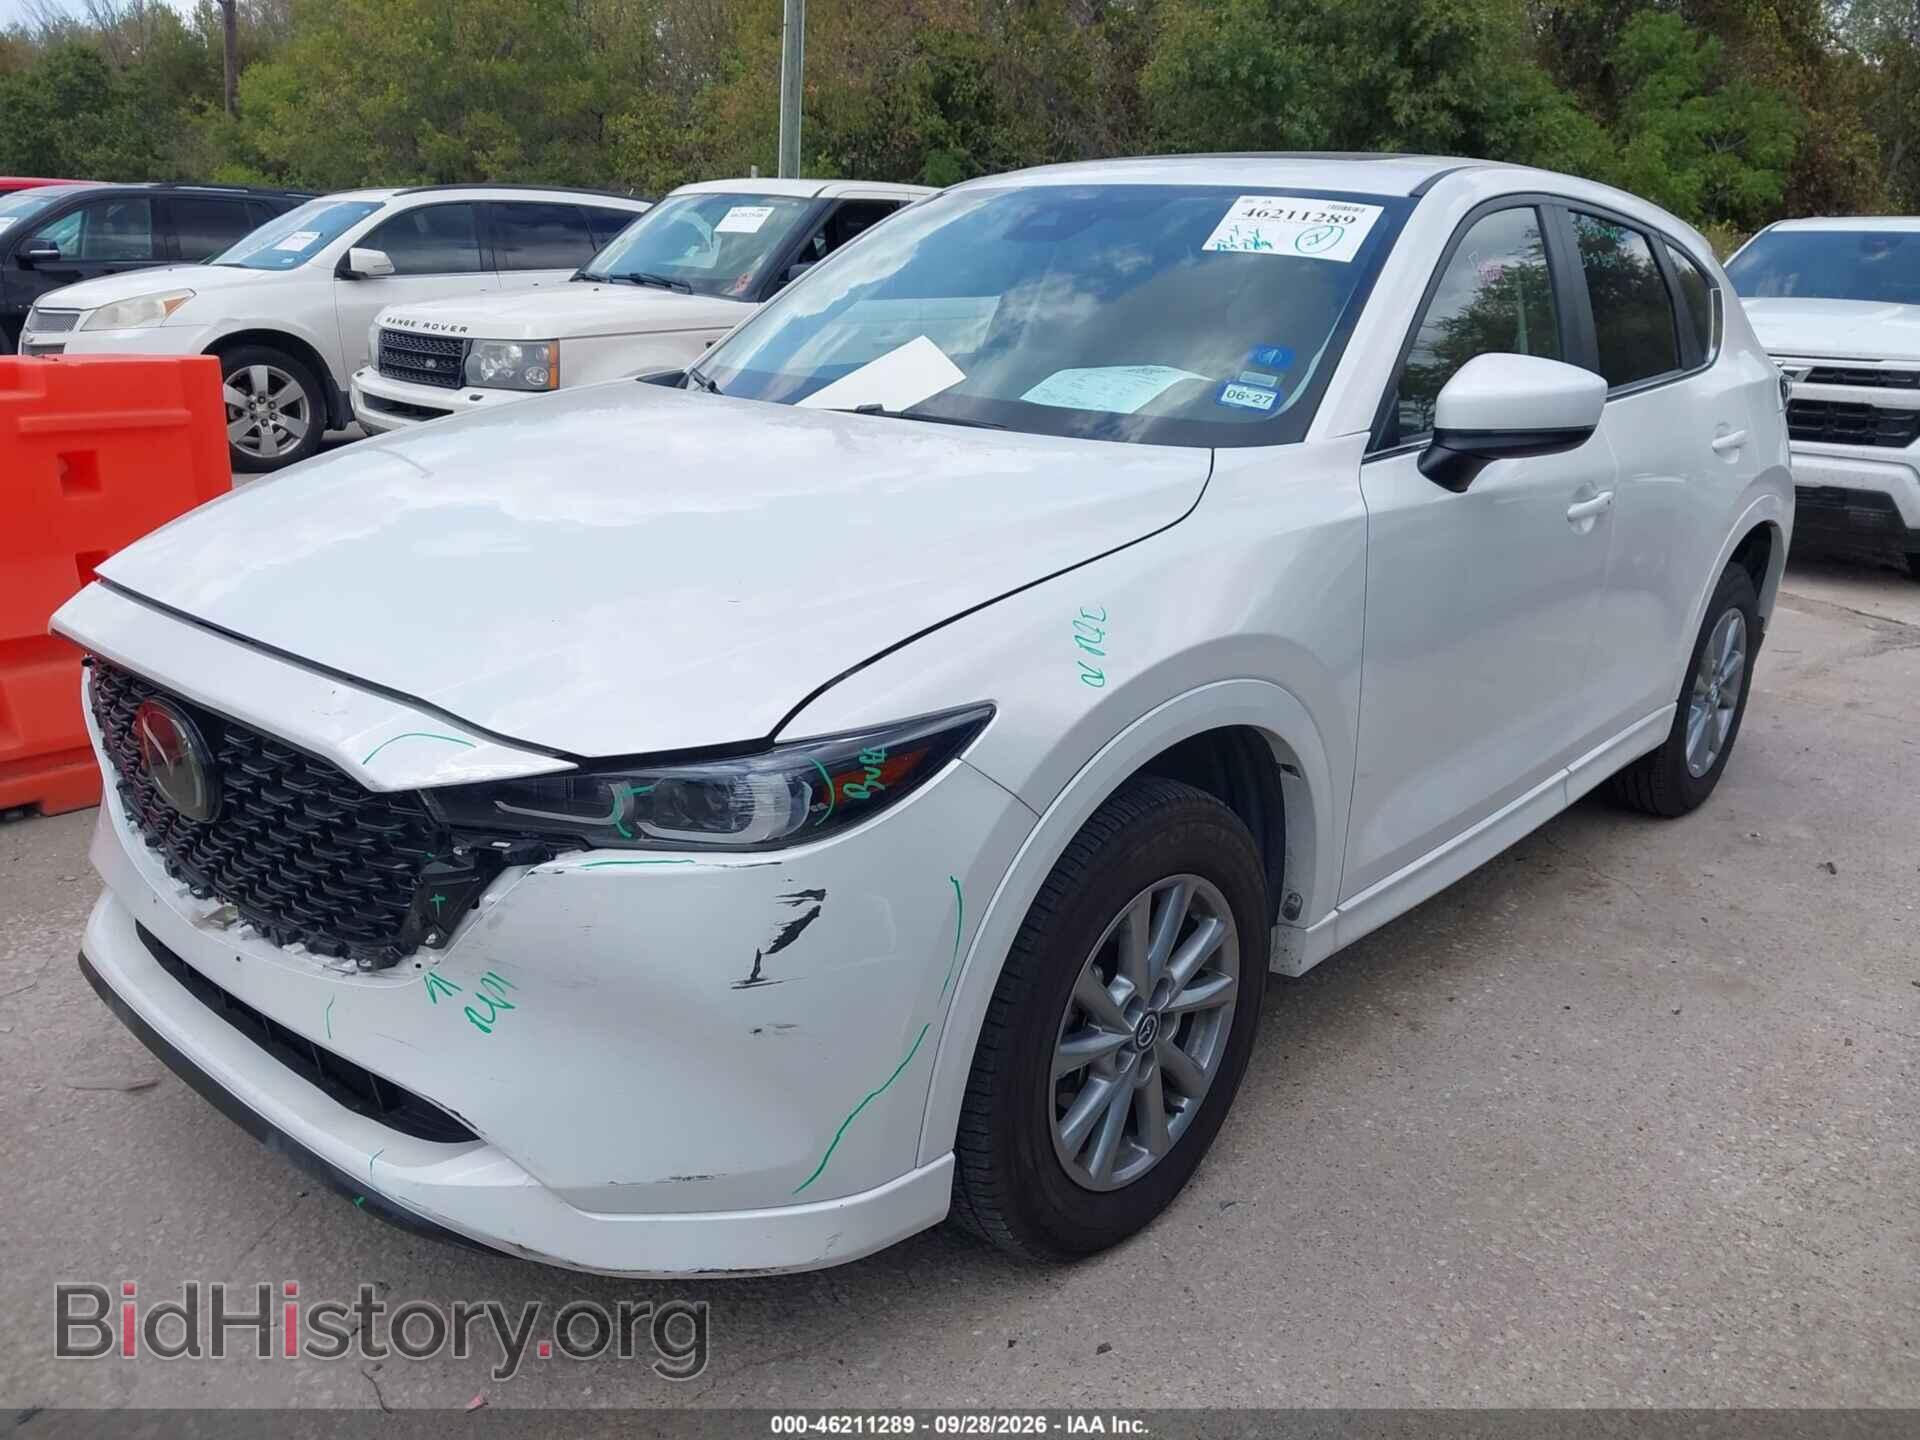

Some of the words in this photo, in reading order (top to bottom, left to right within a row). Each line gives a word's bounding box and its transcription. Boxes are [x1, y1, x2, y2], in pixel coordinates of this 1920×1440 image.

[1241, 207, 1357, 225] 46211289
[386, 317, 416, 327] RANGE
[423, 322, 468, 333] ROVER
